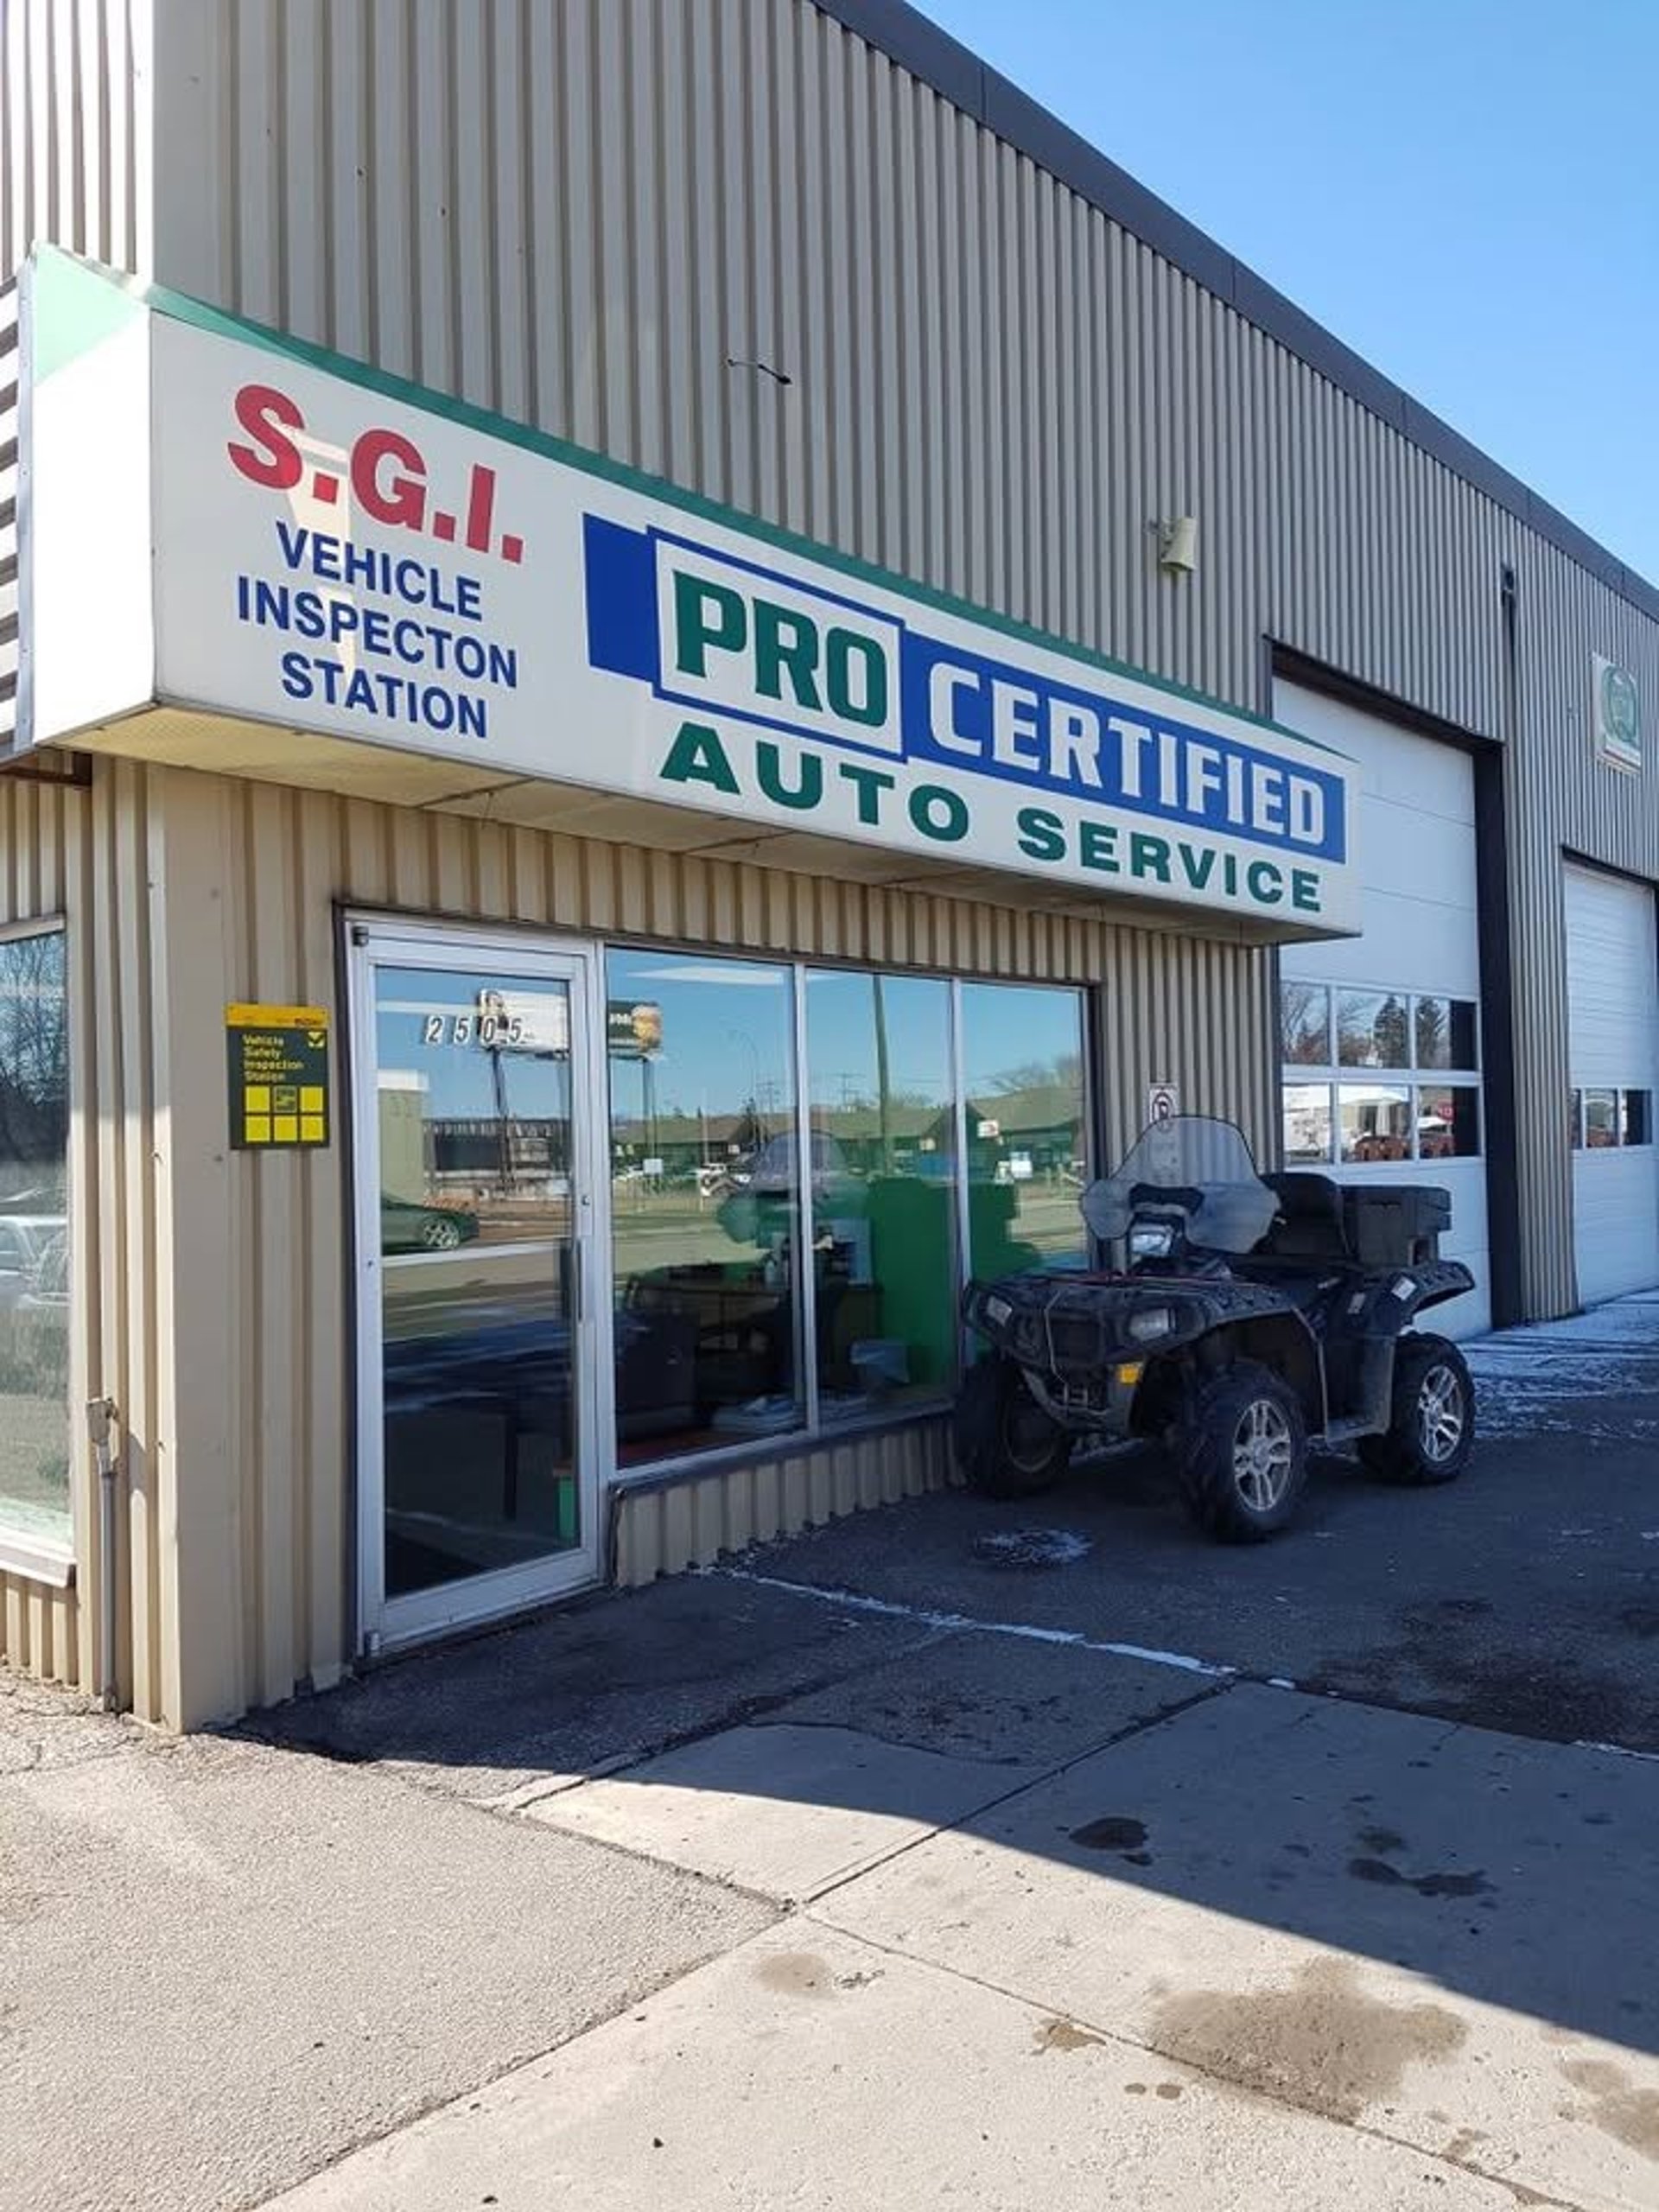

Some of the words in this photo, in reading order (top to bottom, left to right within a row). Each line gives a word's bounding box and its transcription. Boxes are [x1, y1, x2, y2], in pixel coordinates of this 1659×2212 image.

[227, 385, 523, 563] S.G.I.
[276, 521, 481, 621] VEHICLE
[238, 576, 517, 688] INSPECTON
[282, 652, 486, 738] STATION
[672, 570, 887, 728] PRO
[930, 661, 1324, 845] CERTIFIED
[660, 721, 969, 841] AUTO
[1017, 807, 1321, 912] SERVICE
[244, 1047, 282, 1059] Safety
[244, 1059, 304, 1071] Inspection
